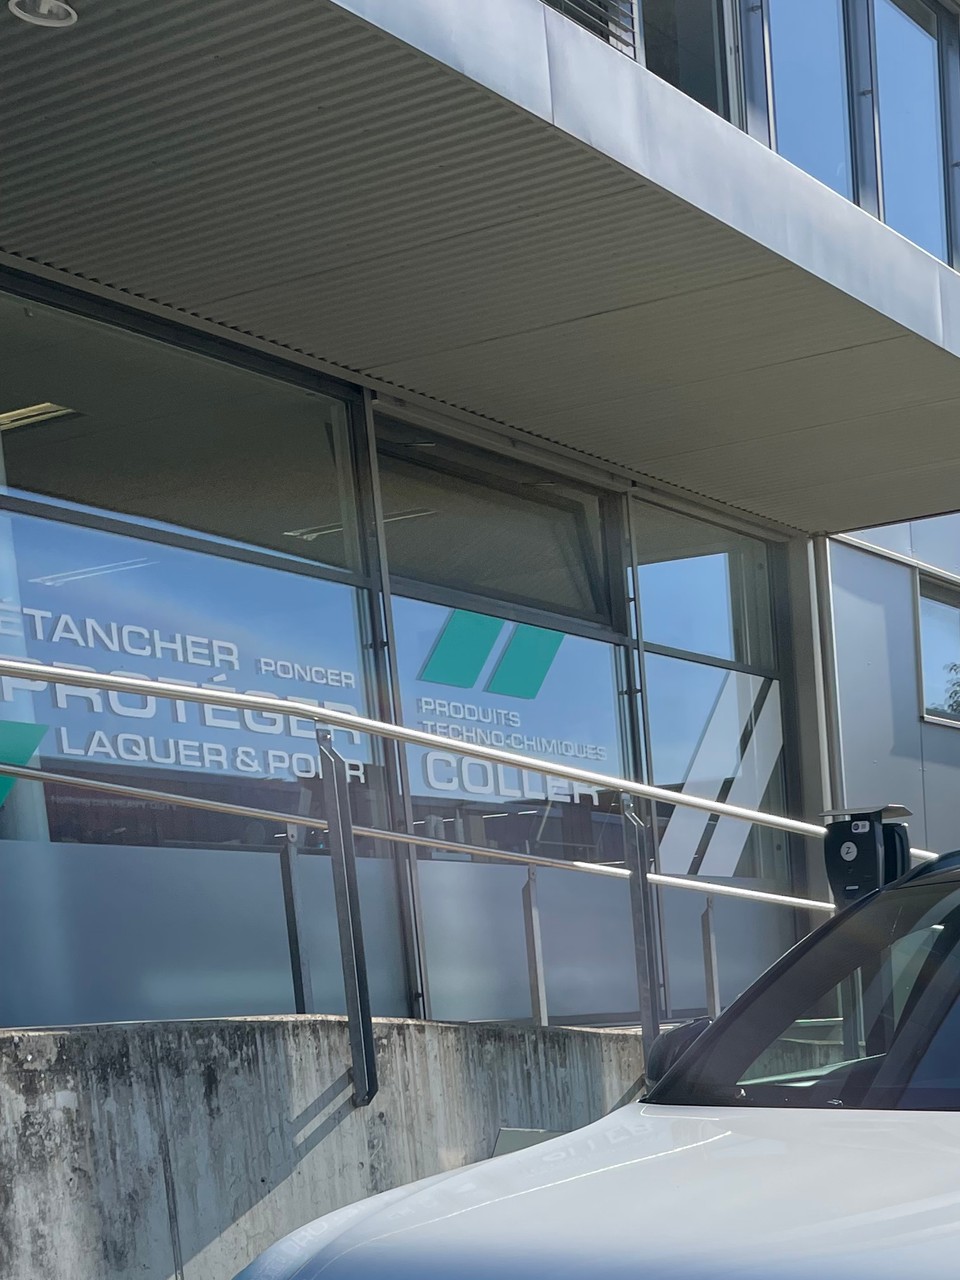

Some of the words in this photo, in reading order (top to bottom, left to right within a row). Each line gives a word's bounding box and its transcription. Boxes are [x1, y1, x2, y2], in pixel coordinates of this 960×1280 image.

[260, 657, 356, 689] PONCER
[421, 697, 520, 728] PRODUITS
[60, 727, 228, 770] LAQUER
[235, 746, 262, 773] &
[422, 720, 607, 761] TECHNO-CHIMIQUES
